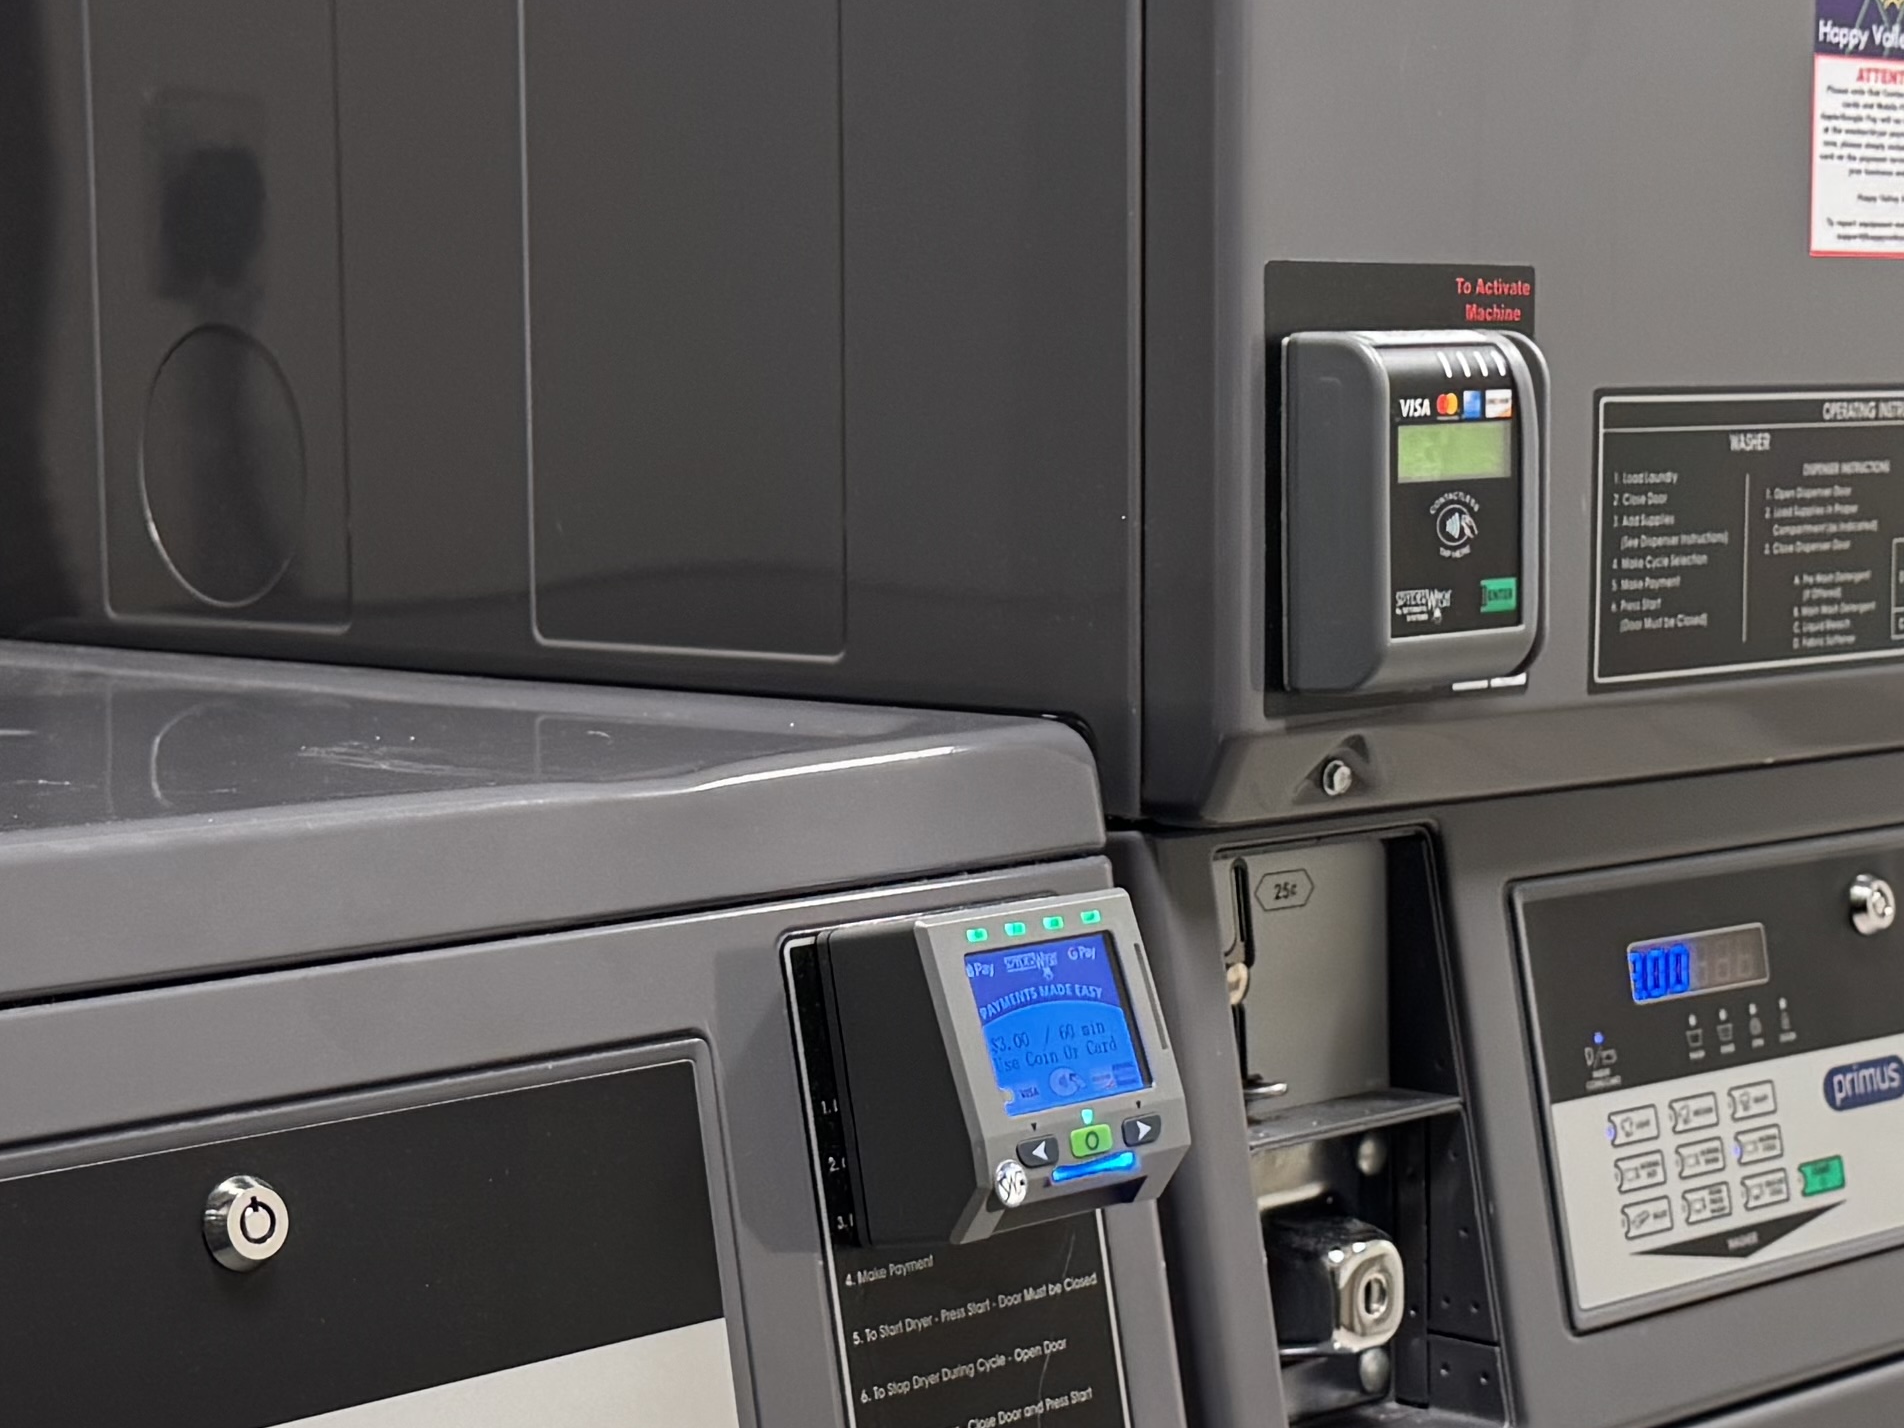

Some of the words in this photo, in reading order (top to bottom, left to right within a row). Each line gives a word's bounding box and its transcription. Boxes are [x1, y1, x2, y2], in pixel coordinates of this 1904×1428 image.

[1818, 19, 1869, 51] Happy
[1455, 277, 1472, 295] To
[1475, 278, 1530, 297] Activate
[1465, 304, 1521, 322] Machine
[1399, 398, 1431, 418] VISA
[1729, 433, 1771, 451] WASHER
[979, 986, 1038, 1020] PAYMENTS
[1038, 983, 1072, 997] MADE
[1074, 983, 1104, 1000] EASY
[1081, 1021, 1106, 1038] min
[1025, 1049, 1059, 1068] Coin
[1064, 1044, 1079, 1061] Or
[1086, 1036, 1118, 1056] Card
[1833, 1062, 1900, 1107] primus
[845, 1274, 857, 1286] 4.
[857, 1266, 888, 1284] Make
[889, 1254, 934, 1277] Payment
[853, 1331, 864, 1346] 5.
[865, 1327, 878, 1343] To
[879, 1320, 904, 1338] Start
[905, 1313, 933, 1333] Dryer
[940, 1306, 966, 1323] Press
[967, 1298, 991, 1317] Start
[998, 1291, 1023, 1309] Door
[1023, 1283, 1047, 1302] Must
[1048, 1281, 1062, 1297] be
[1063, 1271, 1098, 1293] Closed
[860, 1388, 872, 1404] 6.
[873, 1385, 886, 1401] To
[887, 1380, 911, 1399] Stop
[912, 1371, 940, 1390] Dryer
[941, 1361, 975, 1380] During
[976, 1354, 1006, 1374] Cycle
[1014, 1343, 1043, 1363] Open
[1044, 1337, 1067, 1356] Door
[997, 1406, 1023, 1425] Door
[1023, 1399, 1044, 1417] and
[1045, 1394, 1069, 1412] Press
[1070, 1386, 1093, 1404] Start
